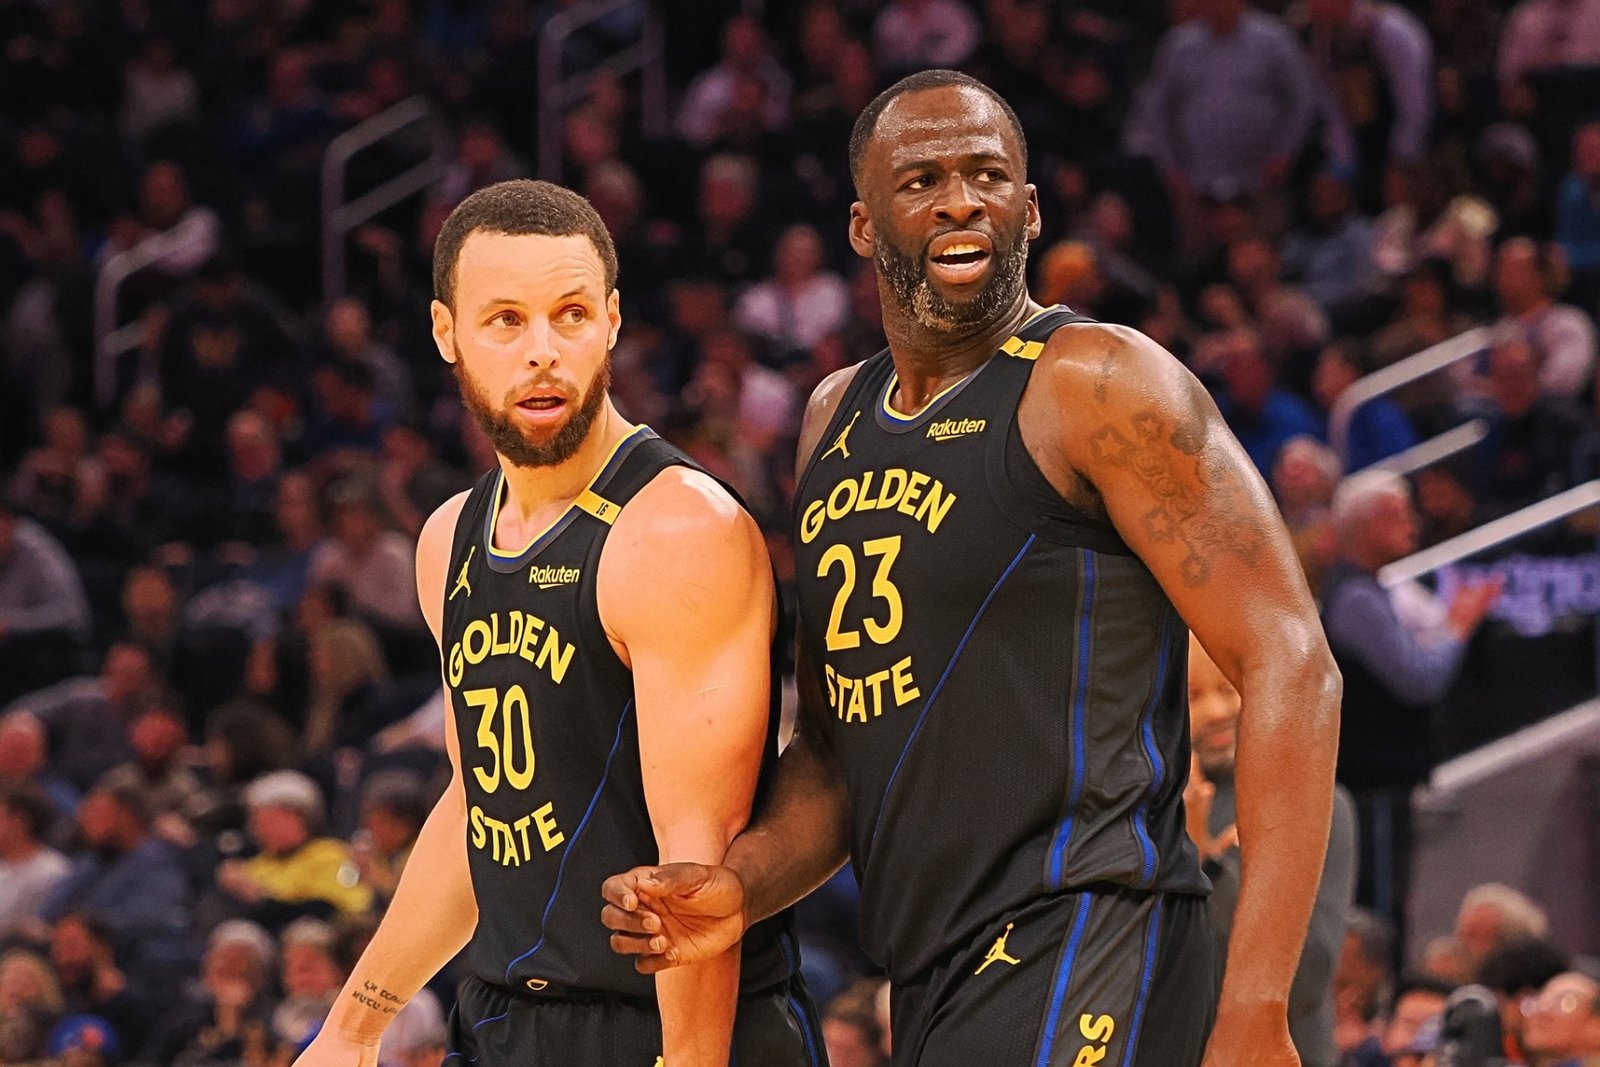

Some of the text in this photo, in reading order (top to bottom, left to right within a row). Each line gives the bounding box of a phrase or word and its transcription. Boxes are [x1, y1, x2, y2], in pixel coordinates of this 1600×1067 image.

[926, 418, 986, 439] Rakuten
[800, 469, 957, 544] GOLDEN
[529, 564, 580, 584] Rakuten
[816, 534, 904, 652] 23
[448, 610, 576, 688] GOLDEN
[825, 655, 921, 723] STATE
[463, 684, 536, 794] 30
[471, 801, 565, 867] STATE
